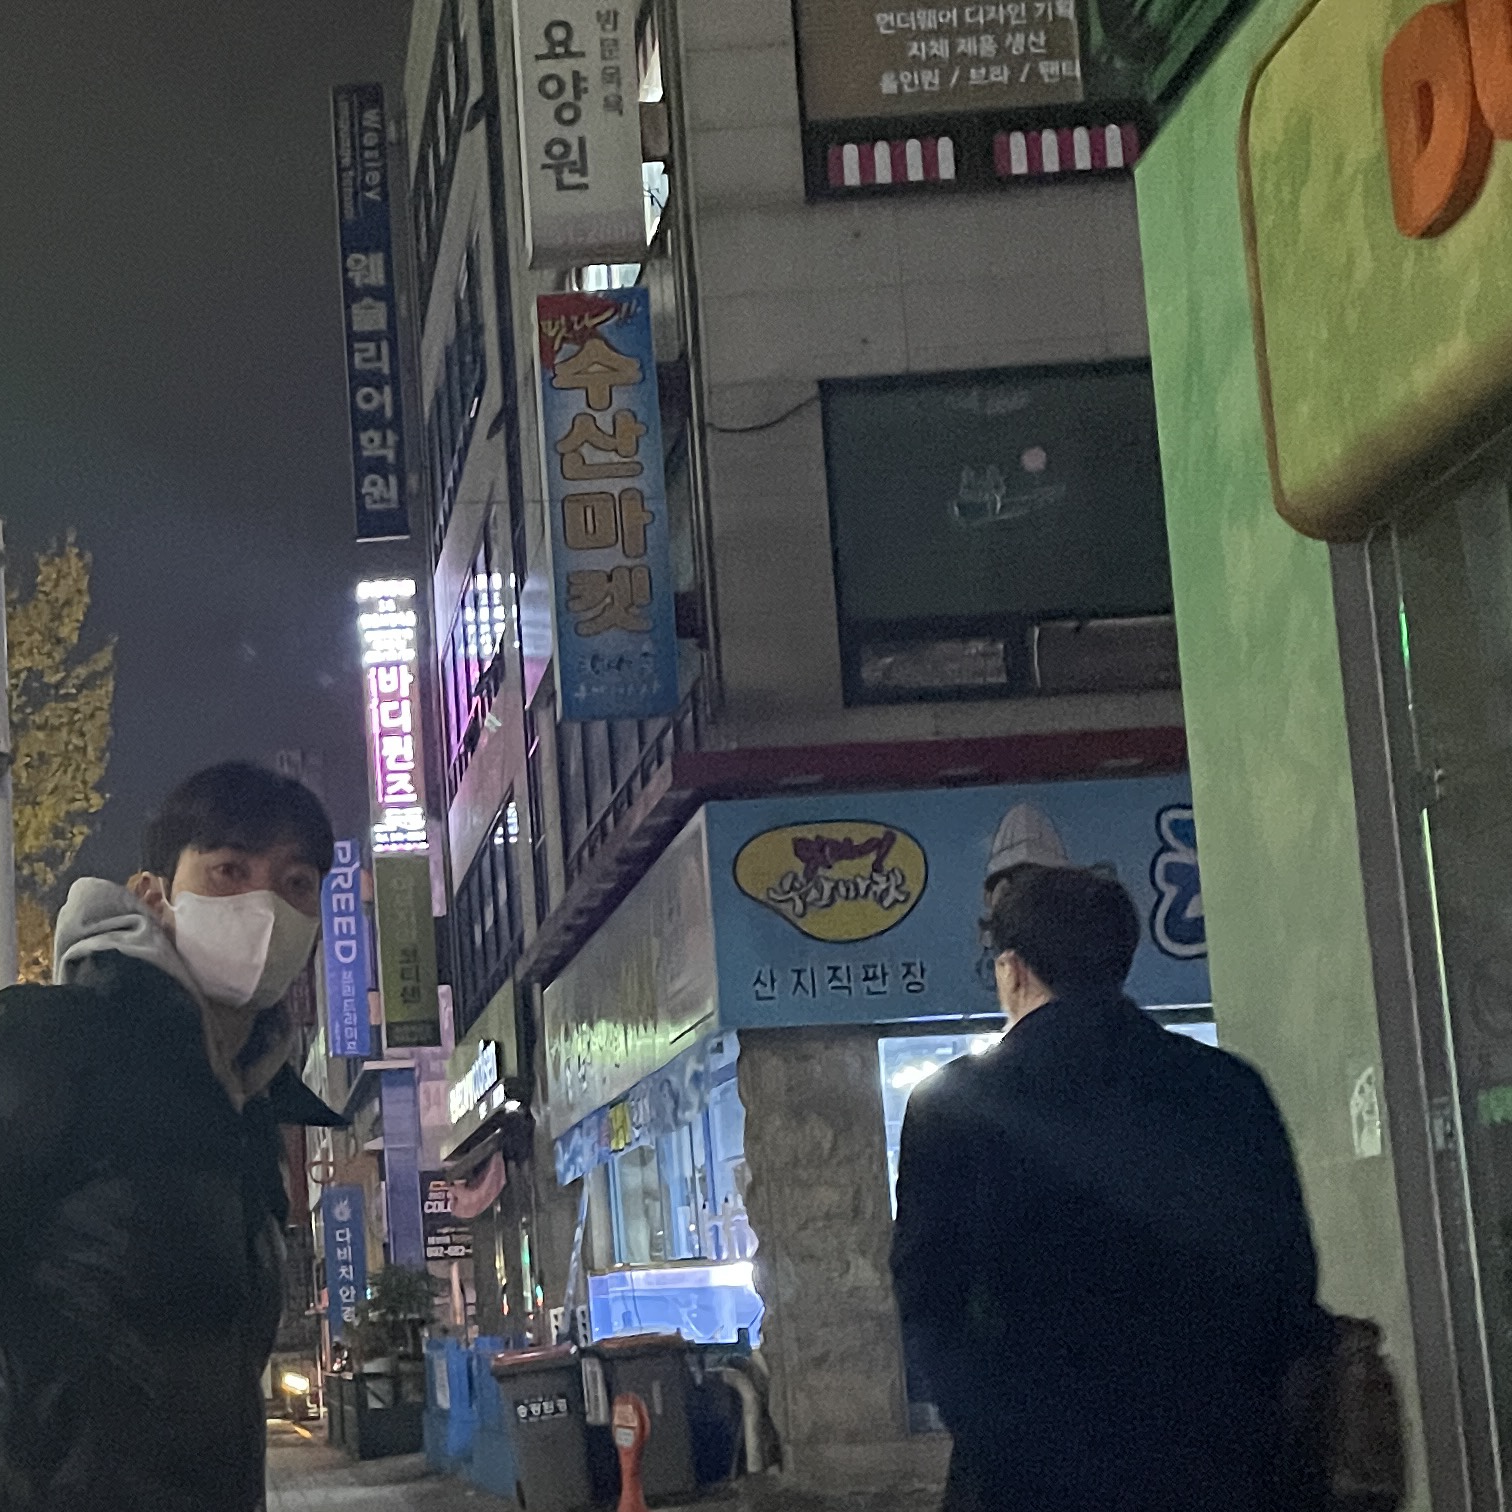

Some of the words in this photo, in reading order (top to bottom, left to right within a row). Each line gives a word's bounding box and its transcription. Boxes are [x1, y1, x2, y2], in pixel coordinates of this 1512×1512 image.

[876, 7, 957, 34] 언더웨어
[965, 3, 1026, 25] 디자인
[908, 39, 950, 60] 자체
[956, 34, 998, 57] 제품
[1005, 30, 1046, 55] 생산
[535, 20, 589, 191] 요양원
[880, 69, 939, 93] 올인원
[969, 65, 1009, 84] 브라
[553, 338, 656, 636] 수산마켓
[330, 840, 361, 964] PREED
[752, 960, 926, 1001] 산지직판장
[334, 1227, 357, 1322] 다비치안경
